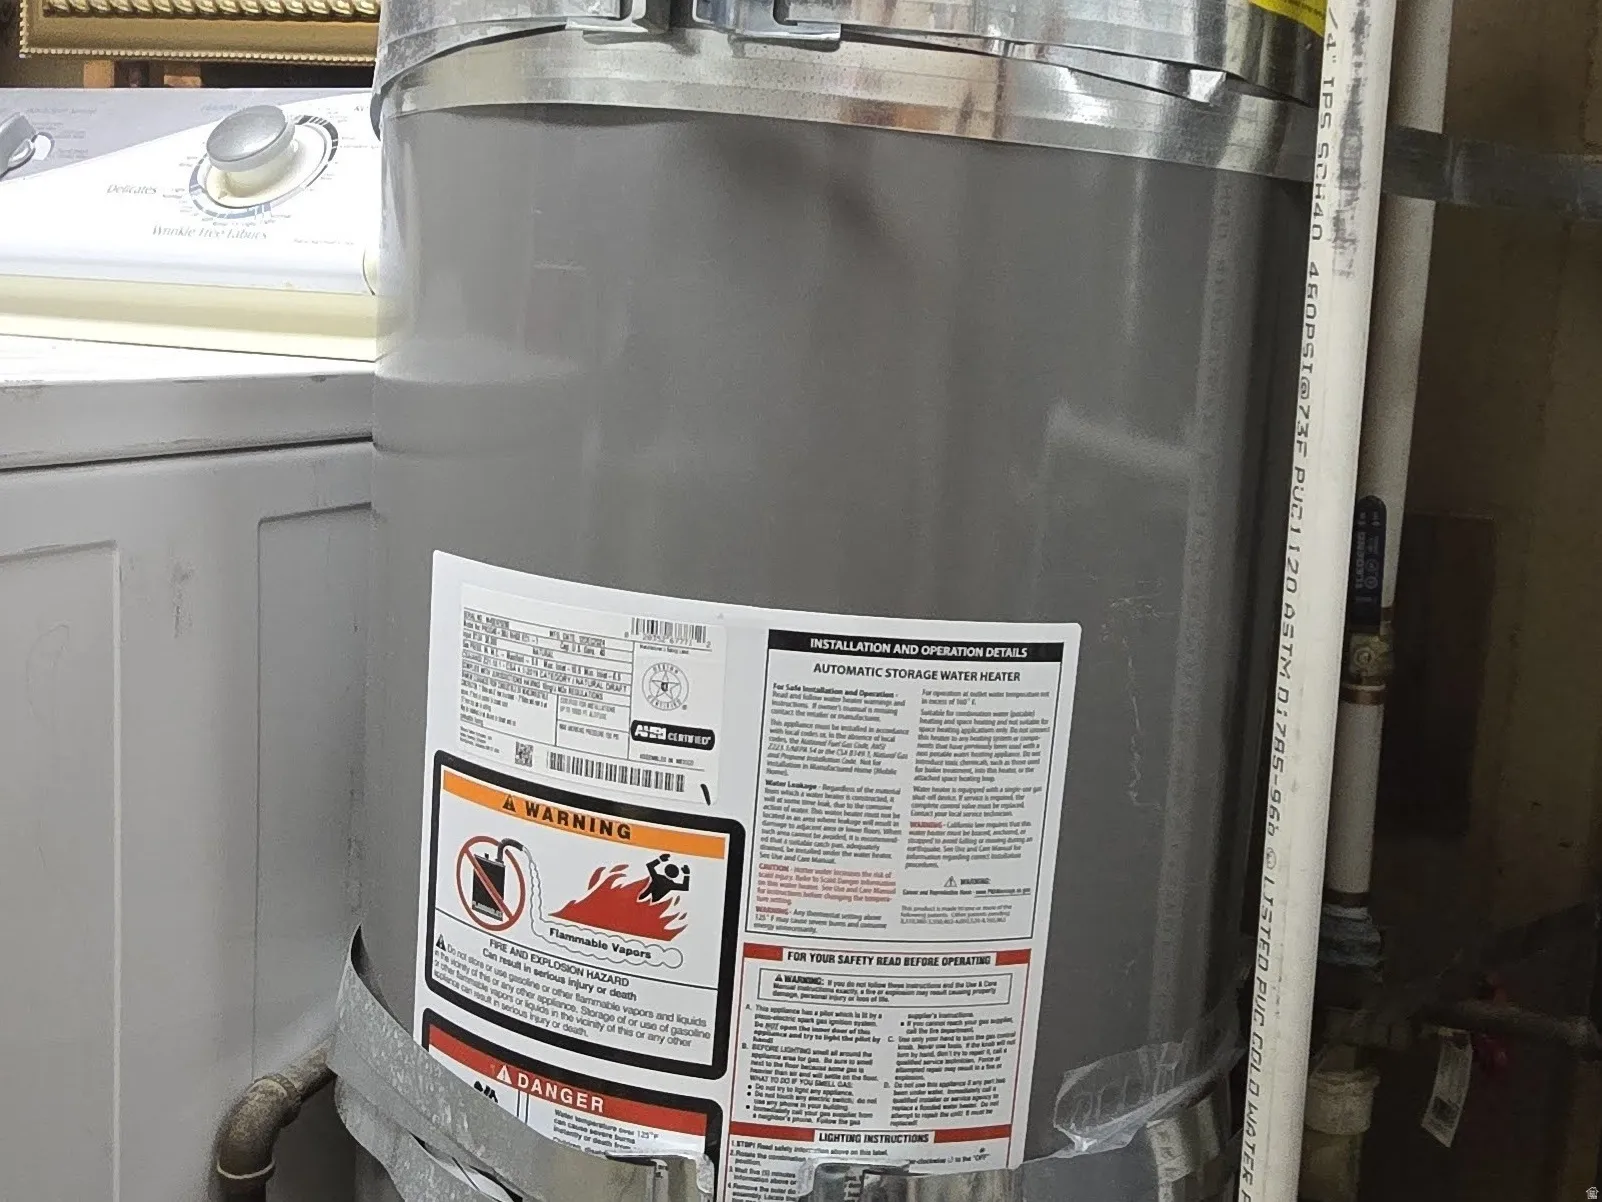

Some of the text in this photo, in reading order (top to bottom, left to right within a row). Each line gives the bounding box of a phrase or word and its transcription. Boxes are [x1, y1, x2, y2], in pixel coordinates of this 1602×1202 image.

[106, 184, 157, 195] Delicates
[1312, 142, 1329, 241] SCH40
[152, 224, 195, 237] Wrinkle
[810, 638, 1028, 659] INSTALLATION AND OPERATION DETAILS
[1279, 609, 1296, 680] ASTM
[773, 682, 894, 698] For Safe Installation and Operation
[814, 662, 1021, 682] AUTOMATIC STORAGE WATER HEATER
[788, 781, 817, 790] Leakage
[524, 800, 632, 840] WARNING
[1258, 876, 1276, 972] LISTED
[549, 926, 652, 960] Flammable Vapors
[787, 951, 991, 967] FOR YOUR SAFETY READ BEFORE OPERATING
[482, 948, 637, 1002] Can result in serious injury or death
[490, 939, 630, 987] FIRE AND EXPLOSION HAZARD
[1248, 1031, 1263, 1097] COLD
[517, 1072, 605, 1113] DANGER
[819, 1132, 929, 1144] LIGHTING INSTRUCTIONS
[1242, 1102, 1260, 1186] WATER
